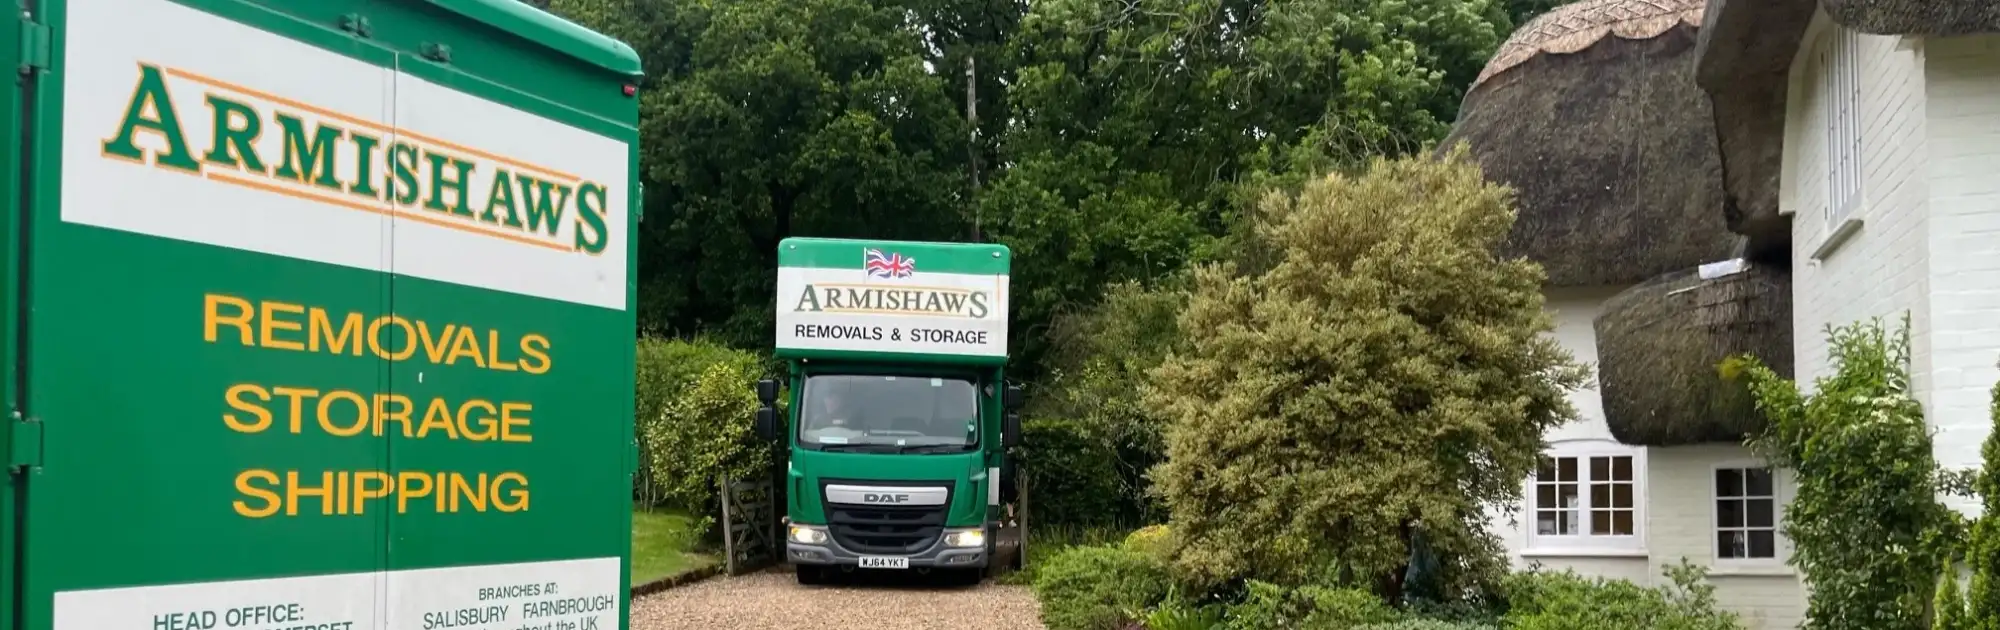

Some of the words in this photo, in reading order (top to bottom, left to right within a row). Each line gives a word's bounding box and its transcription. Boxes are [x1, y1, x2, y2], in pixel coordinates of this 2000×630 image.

[101, 61, 609, 257] ARMISHAWS
[794, 284, 989, 319] ARMISHAWS
[204, 294, 552, 375] REMOVALS
[795, 324, 883, 341] REMOVALS
[891, 328, 902, 341] &
[911, 329, 988, 345] STORAGE
[223, 383, 533, 443] STORAGE
[232, 469, 530, 518] SHIPPING
[864, 493, 909, 503] DAF
[888, 558, 905, 567] YKT
[478, 583, 541, 601] BRANCHES
[544, 582, 559, 595] AT:
[153, 611, 217, 630] HEAD
[225, 603, 304, 627] OFFICE:
[423, 605, 510, 630] SALISBURY
[523, 595, 615, 619] FARNBROUGH
[580, 615, 598, 630] UK
